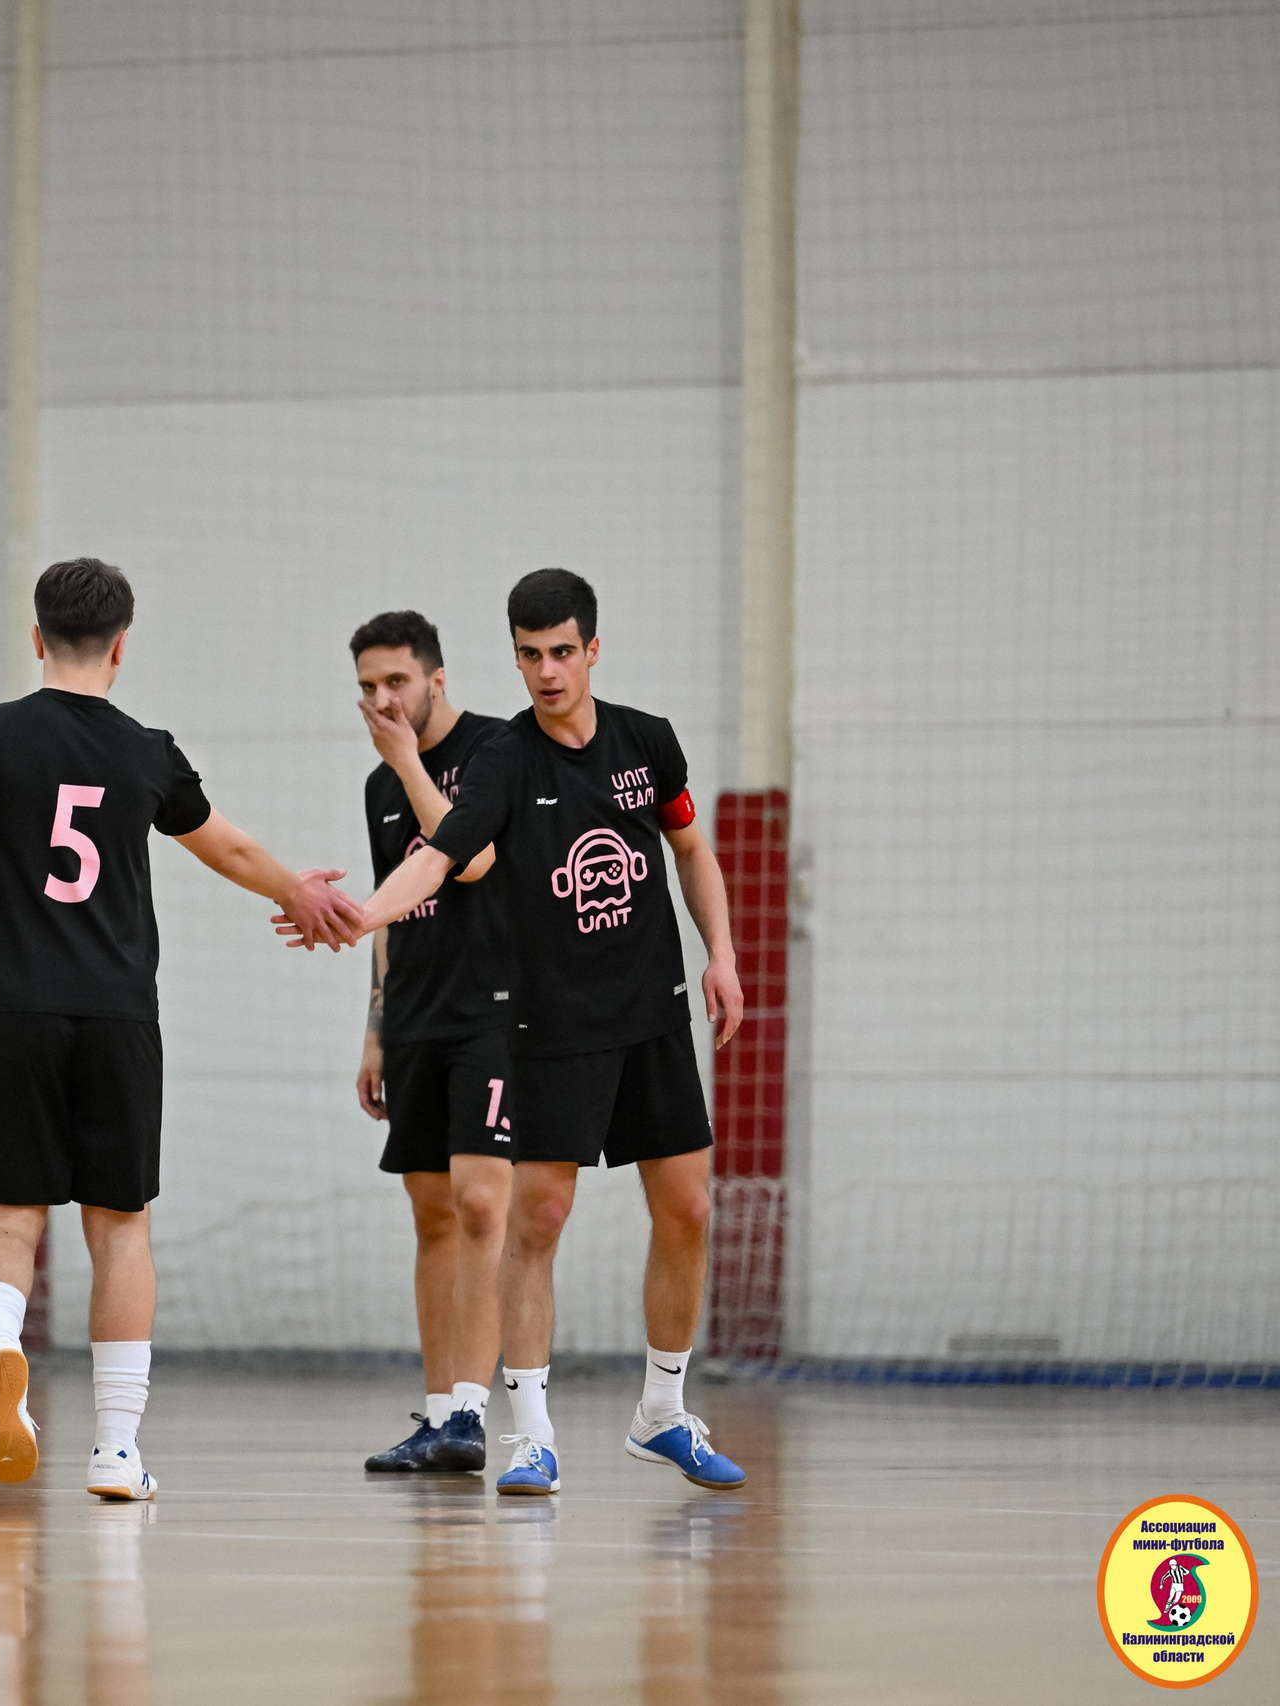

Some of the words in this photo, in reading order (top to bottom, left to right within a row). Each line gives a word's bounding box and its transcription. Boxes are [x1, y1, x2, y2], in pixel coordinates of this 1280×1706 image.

[611, 766, 650, 791] UNIT
[613, 786, 655, 811] TEAM
[43, 783, 106, 904] 5
[397, 898, 439, 923] IT
[577, 906, 633, 934] UNIT
